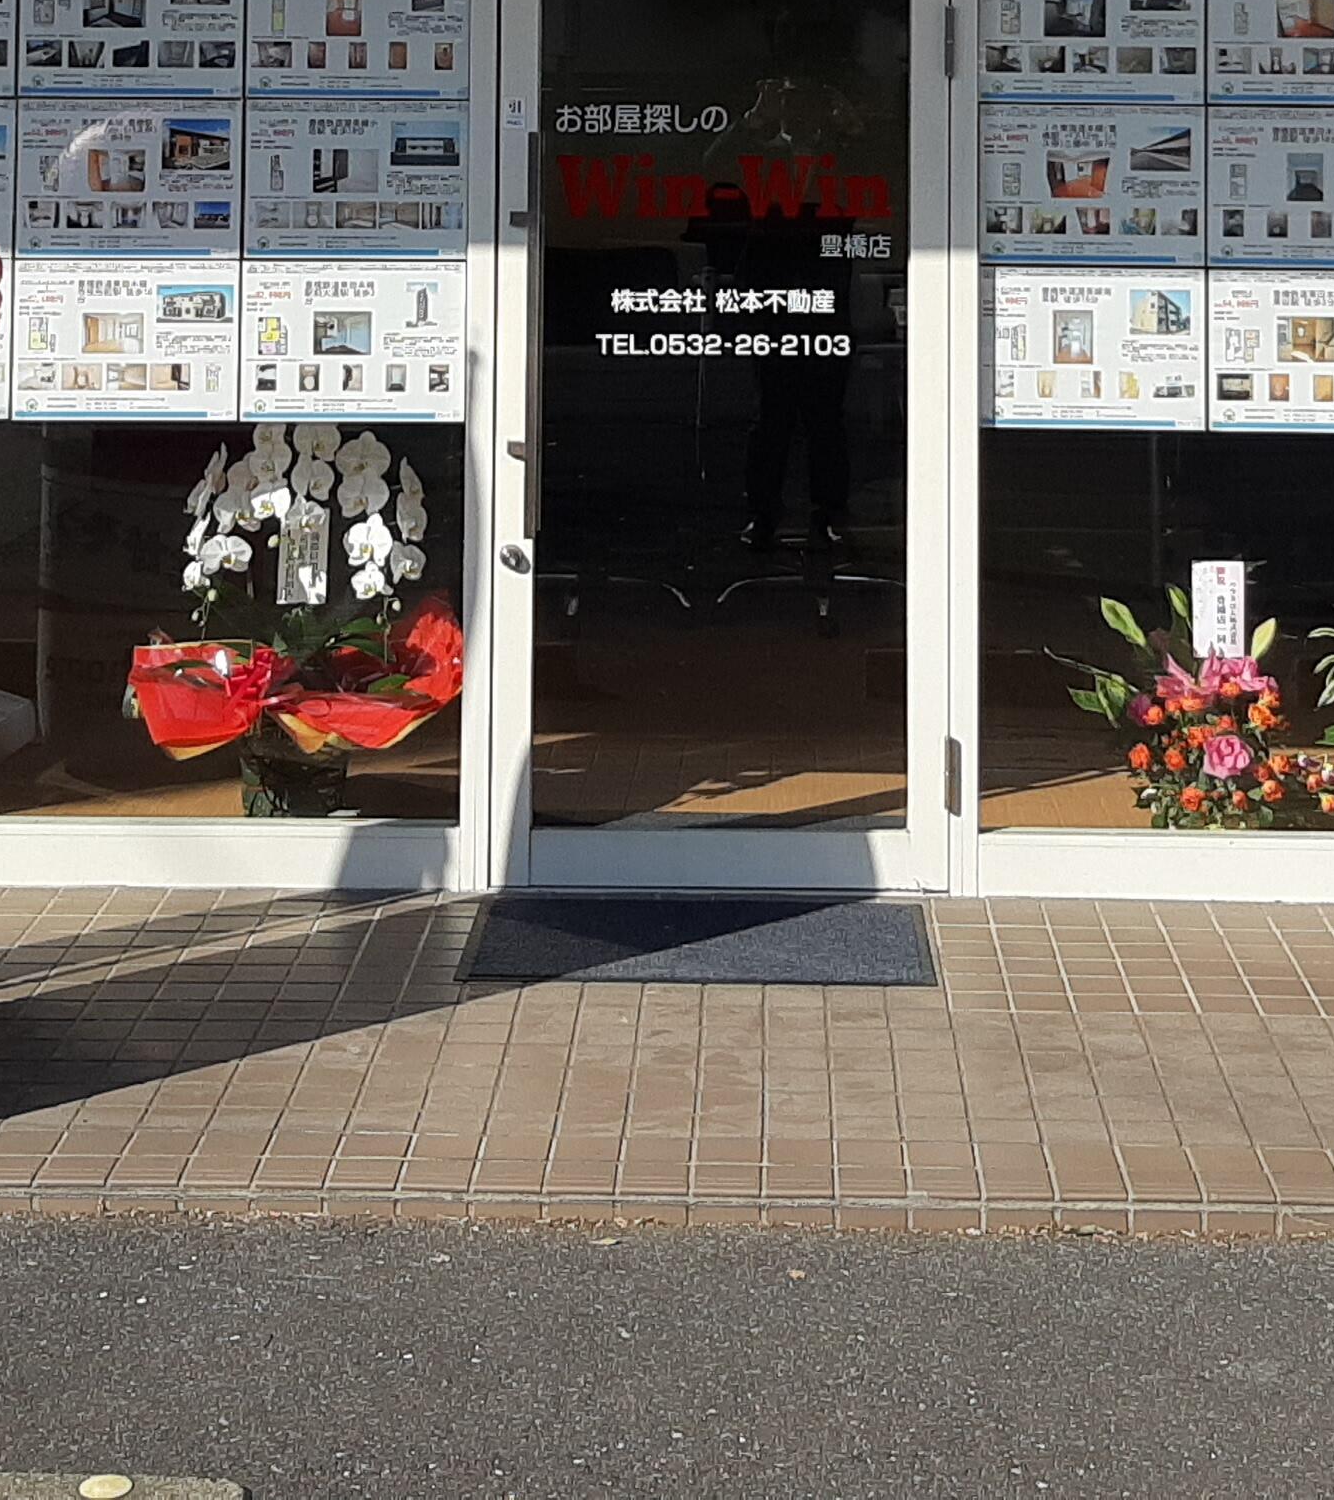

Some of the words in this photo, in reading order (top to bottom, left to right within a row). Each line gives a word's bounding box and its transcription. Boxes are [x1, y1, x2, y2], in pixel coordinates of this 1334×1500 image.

[555, 104, 728, 134] お部屋探しの
[558, 153, 893, 219] Win-Win
[819, 233, 892, 259] 豊橋店
[610, 288, 707, 314] 株式会社
[715, 288, 836, 314] 松本不動産
[595, 333, 851, 357] TEL.0532-26-2103
